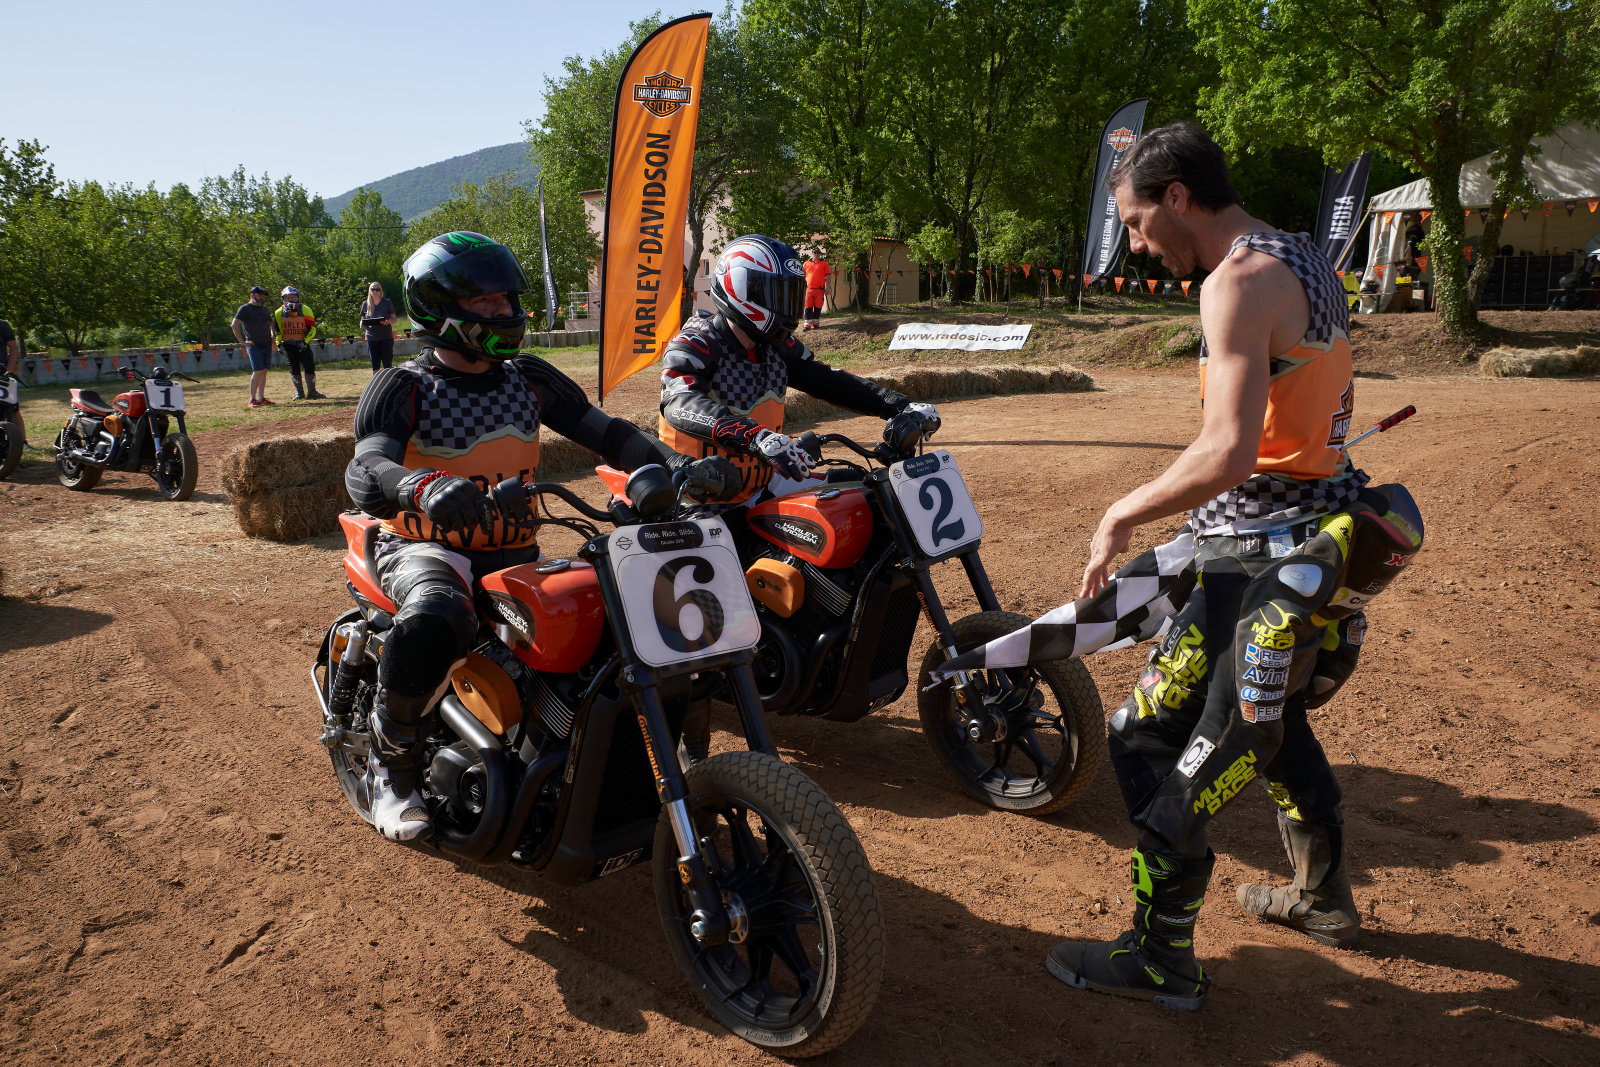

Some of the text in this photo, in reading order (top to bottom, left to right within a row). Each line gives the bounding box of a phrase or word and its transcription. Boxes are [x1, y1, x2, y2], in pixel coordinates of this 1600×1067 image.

[637, 88, 688, 101] HARLEY-DAVIDSON
[650, 78, 678, 87] MOTOR
[648, 101, 676, 115] CYCLES
[1328, 195, 1355, 240] MEDIA
[632, 132, 671, 354] HARLEY-DAVIDSON
[1100, 248, 1109, 261] FOR
[159, 387, 176, 409] 1
[918, 477, 966, 548] 2
[774, 522, 818, 545] DAVIDSON
[492, 602, 528, 635] DAVIDSON
[652, 555, 725, 653] 6
[637, 713, 663, 780] Continental
[1193, 749, 1258, 814] MUGEN
[1206, 765, 1257, 815] RACE
